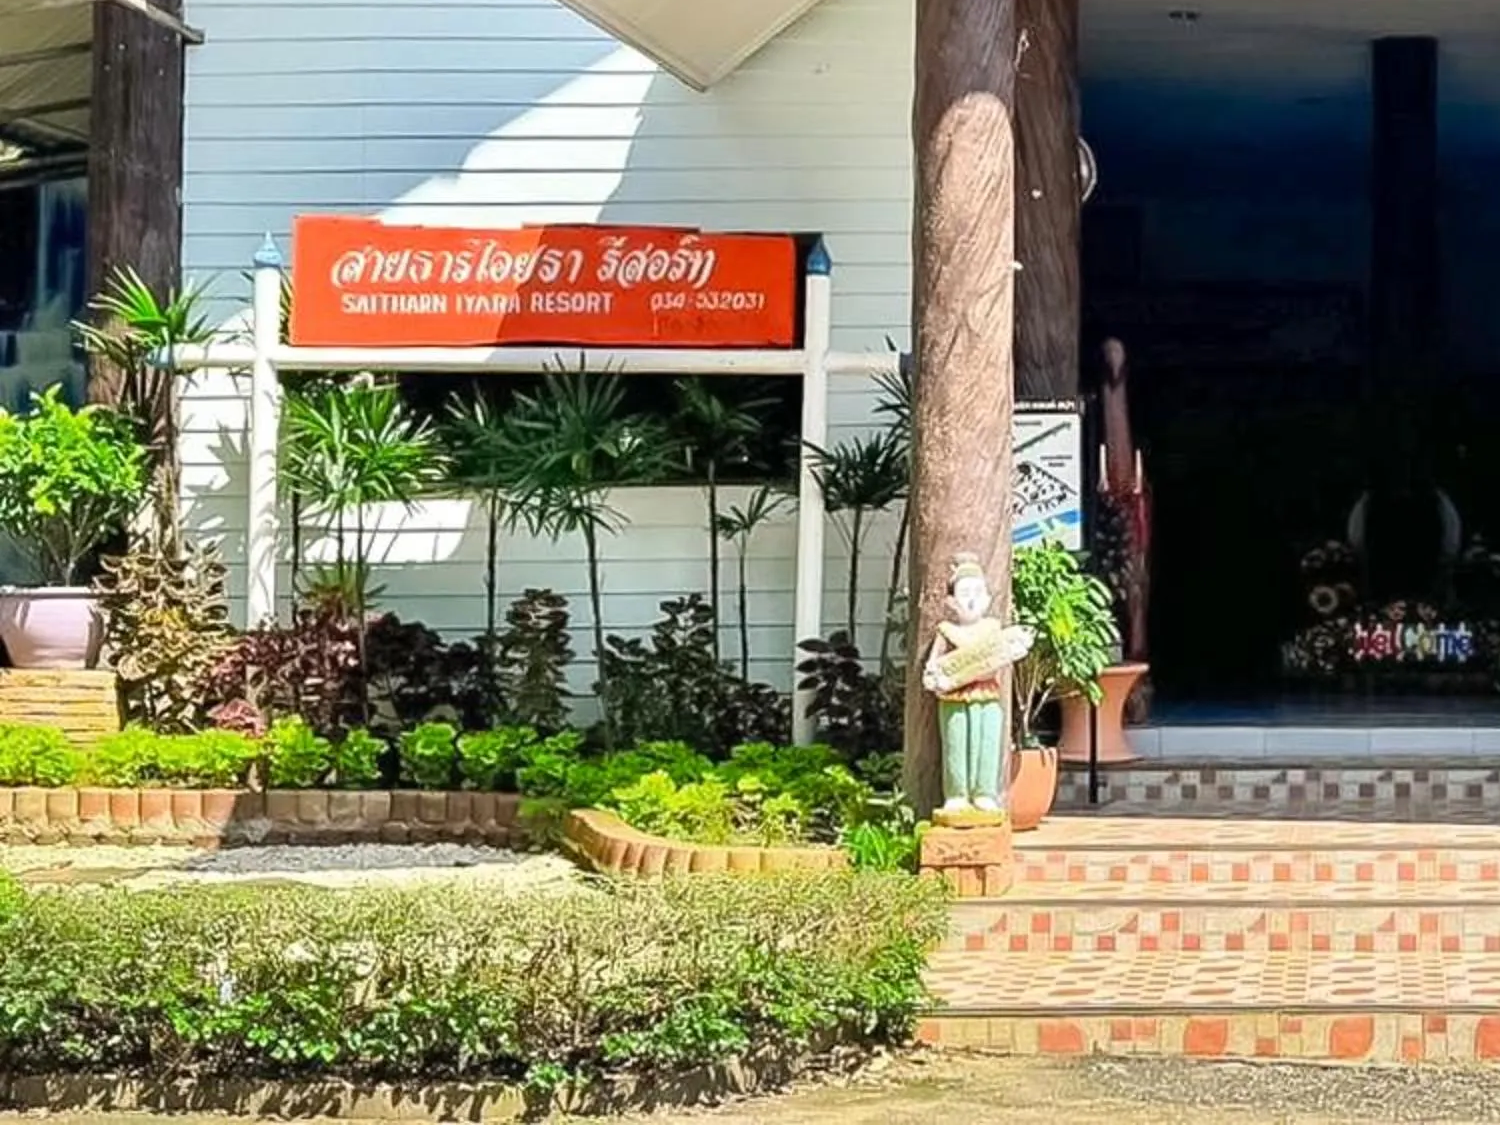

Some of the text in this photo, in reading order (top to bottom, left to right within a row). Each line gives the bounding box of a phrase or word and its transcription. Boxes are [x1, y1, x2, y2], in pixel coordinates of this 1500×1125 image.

[341, 293, 447, 314] SAITHARN
[455, 293, 521, 314] IYARA
[530, 291, 614, 314] RESORT
